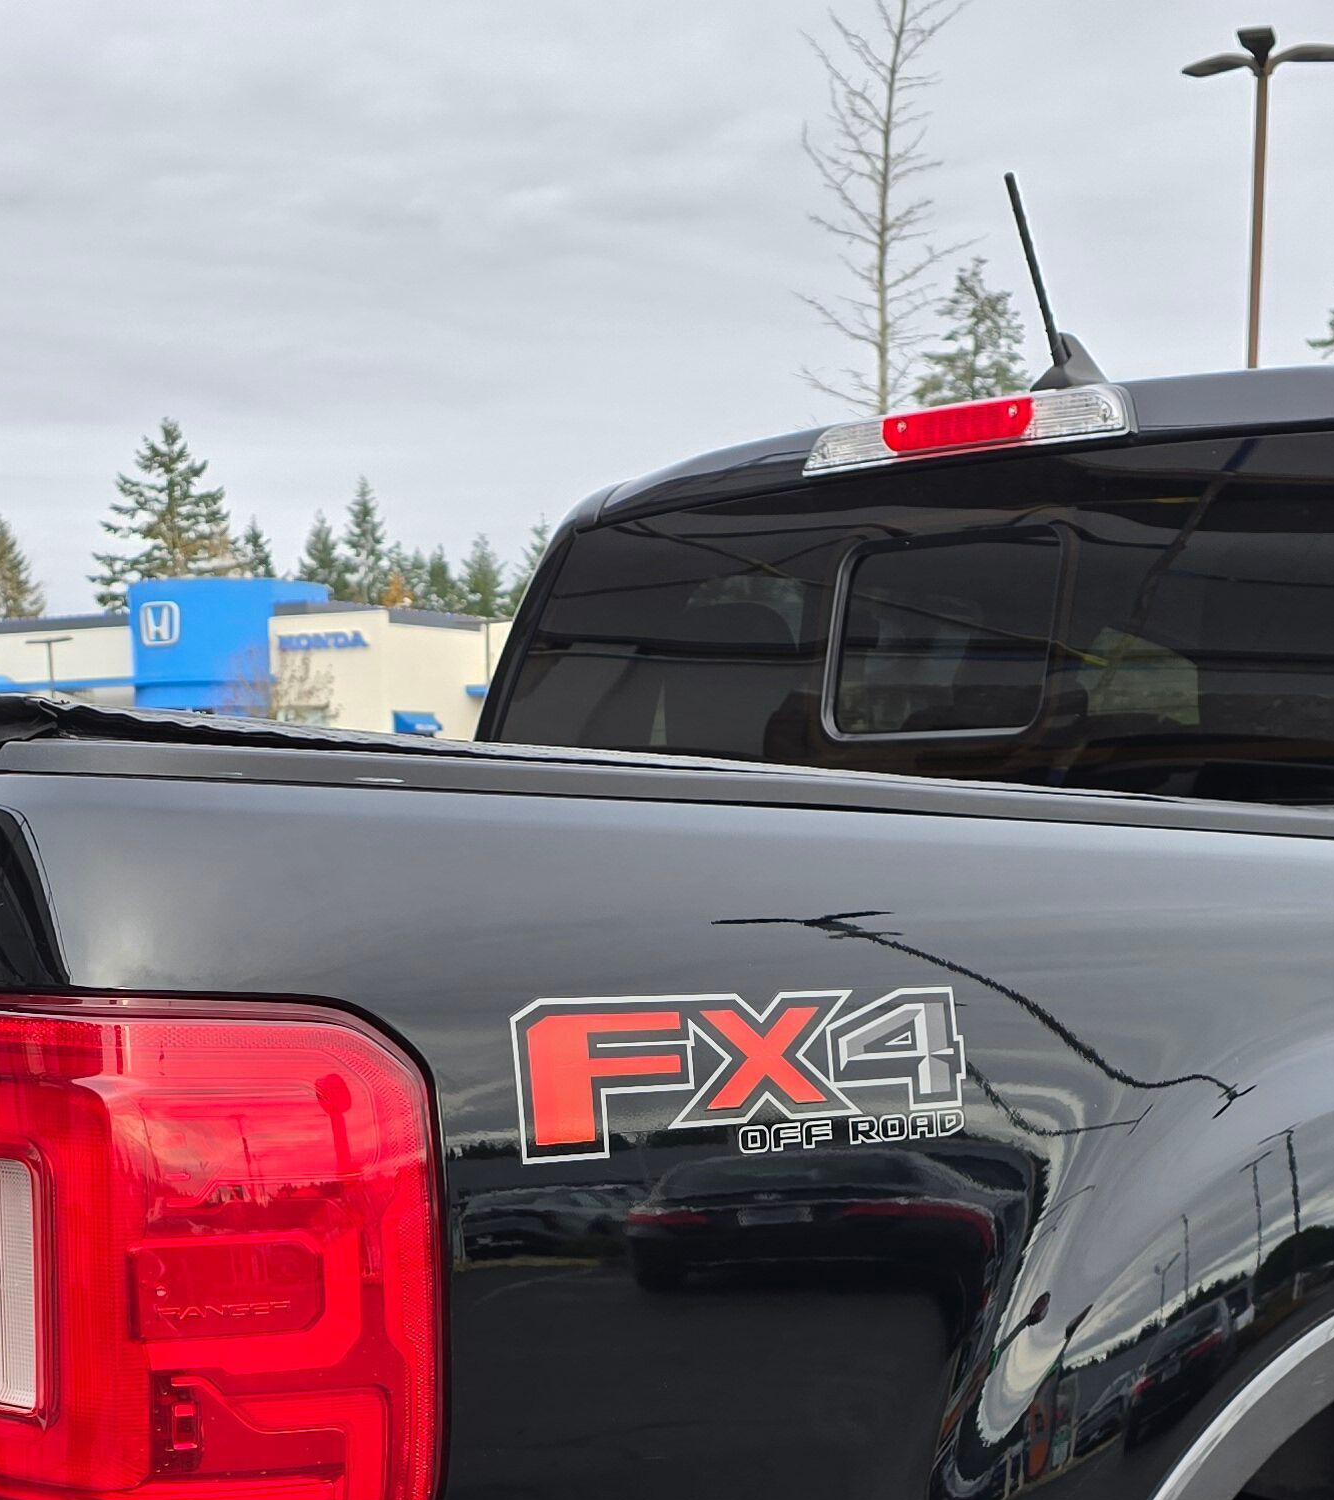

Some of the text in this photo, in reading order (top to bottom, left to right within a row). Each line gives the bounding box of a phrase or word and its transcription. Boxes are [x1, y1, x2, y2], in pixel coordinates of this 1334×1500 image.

[278, 629, 369, 651] HONDA
[509, 986, 967, 1164] FX4
[739, 1108, 965, 1155] OFF ROAD
